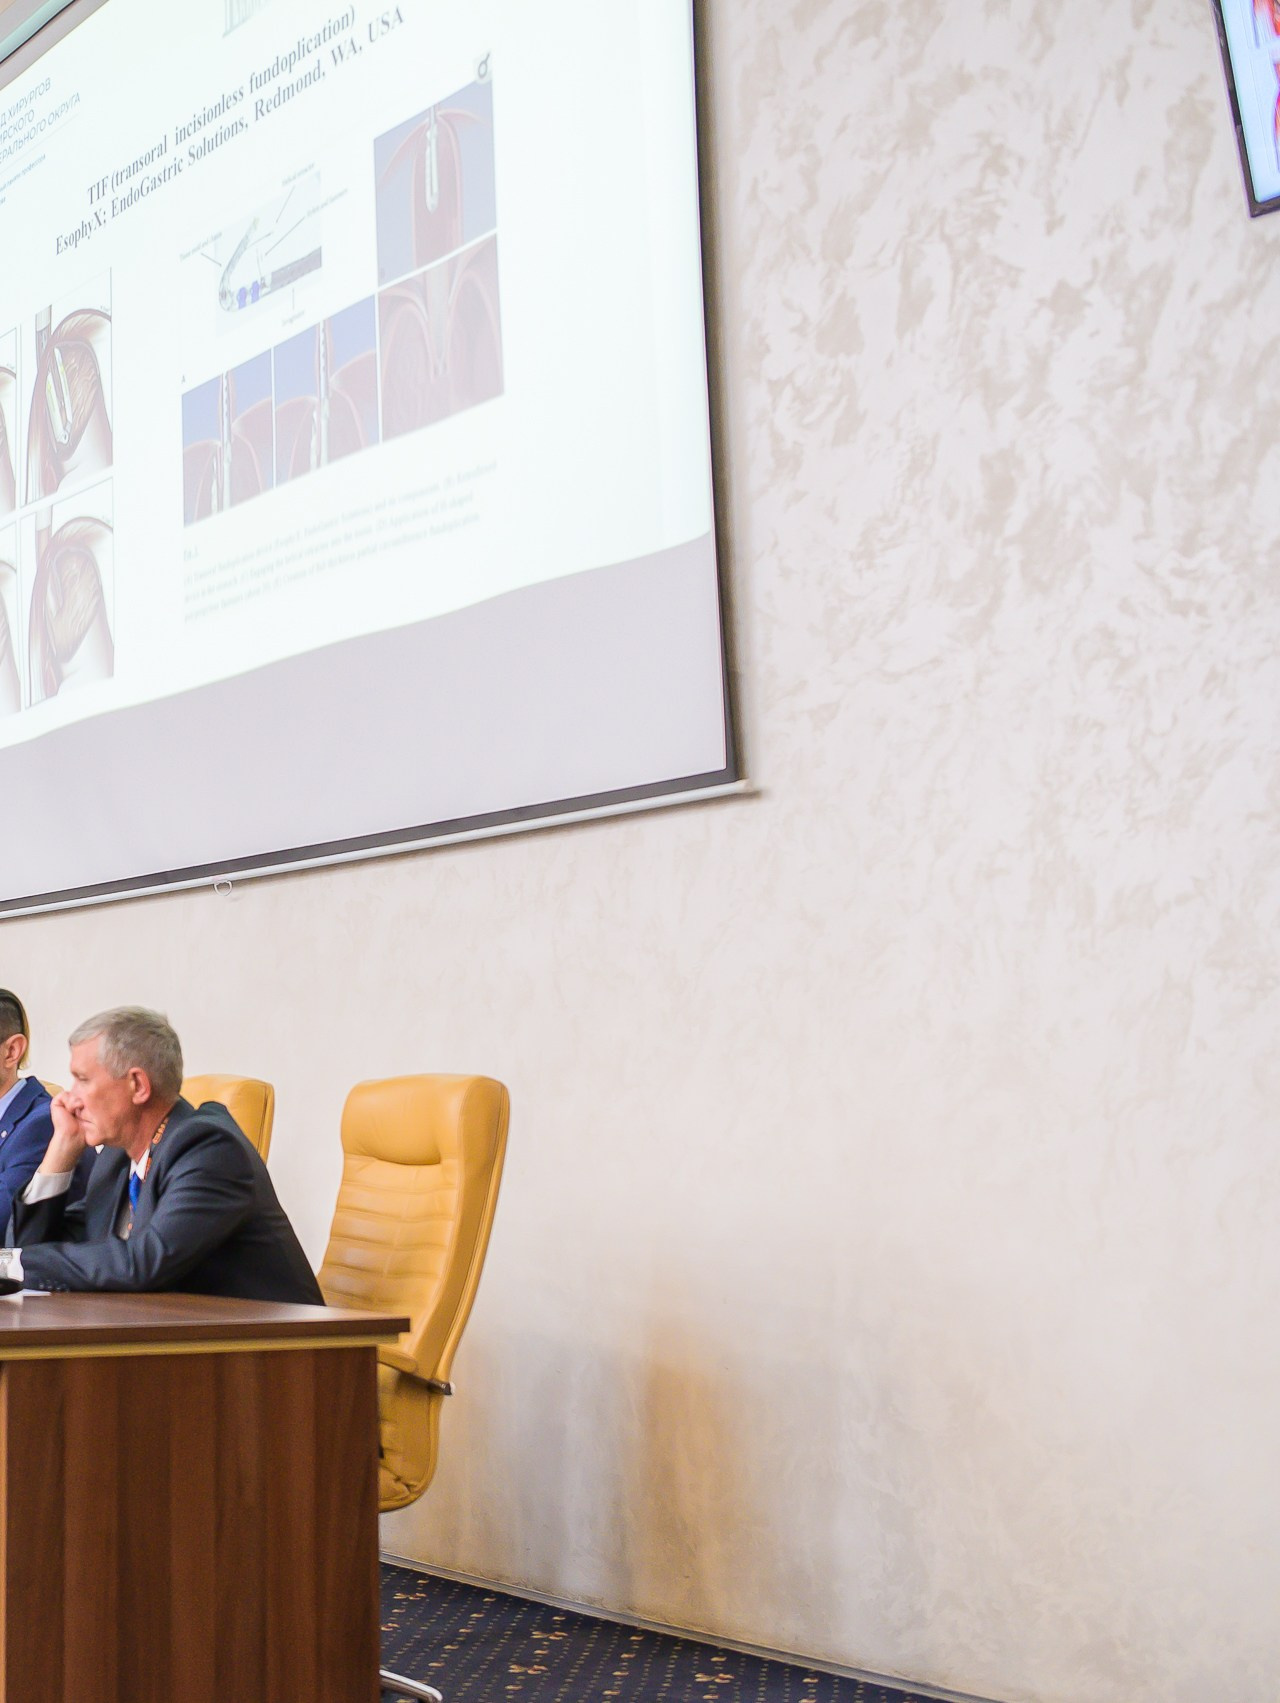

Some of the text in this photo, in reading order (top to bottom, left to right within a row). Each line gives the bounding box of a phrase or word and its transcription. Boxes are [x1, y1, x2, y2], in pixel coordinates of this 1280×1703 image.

[8, 77, 51, 121] ХИРУРГОВ
[47, 92, 81, 126] ОКРУГА
[56, 208, 107, 256] EsophyX;
[111, 157, 184, 219] EndoGastric
[188, 117, 249, 167] Solutions,
[254, 59, 326, 122] Redmond,
[331, 36, 363, 68] WA,
[368, 5, 404, 44] USA
[87, 175, 109, 205] TIF
[111, 134, 168, 192] (transoral
[174, 86, 245, 146] incisionless
[249, 4, 356, 95] fundoplication)
